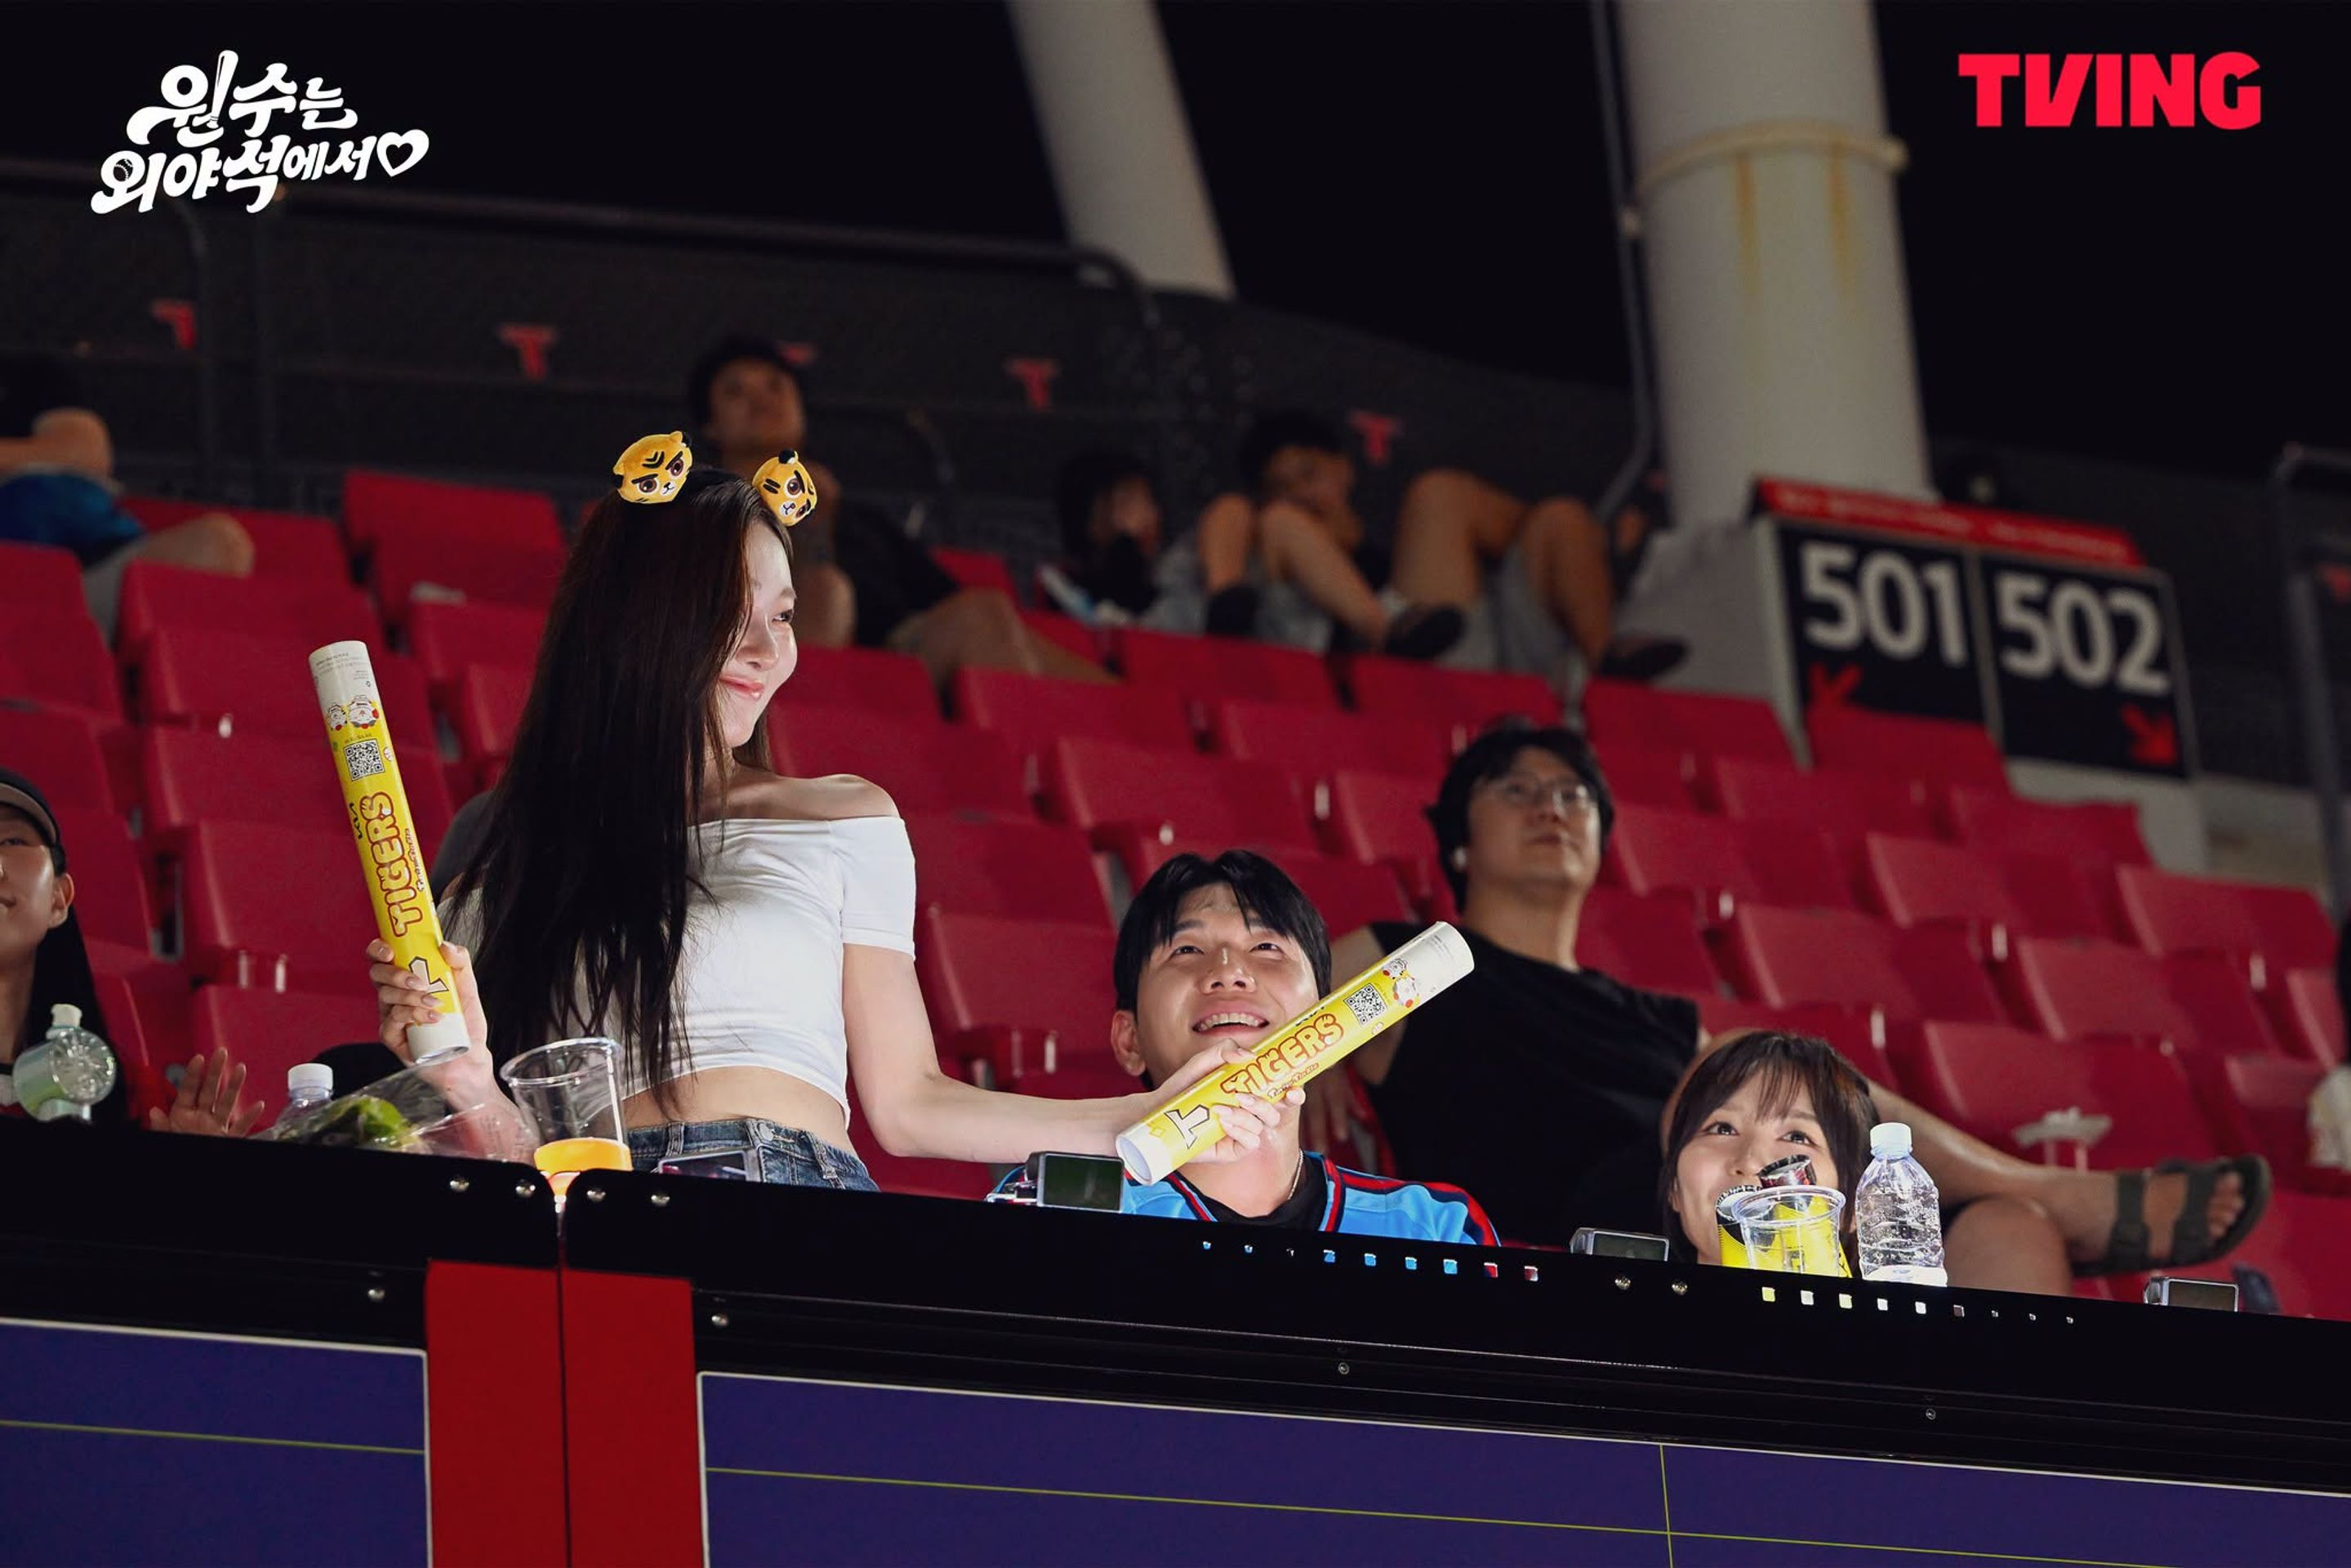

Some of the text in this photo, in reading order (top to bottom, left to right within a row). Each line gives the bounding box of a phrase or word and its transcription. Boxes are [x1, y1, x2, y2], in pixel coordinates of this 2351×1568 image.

[1801, 541, 1969, 667] 501
[1995, 572, 2172, 699] 502
[359, 791, 423, 938] TIGERS
[1220, 1013, 1345, 1100] TIGERS
